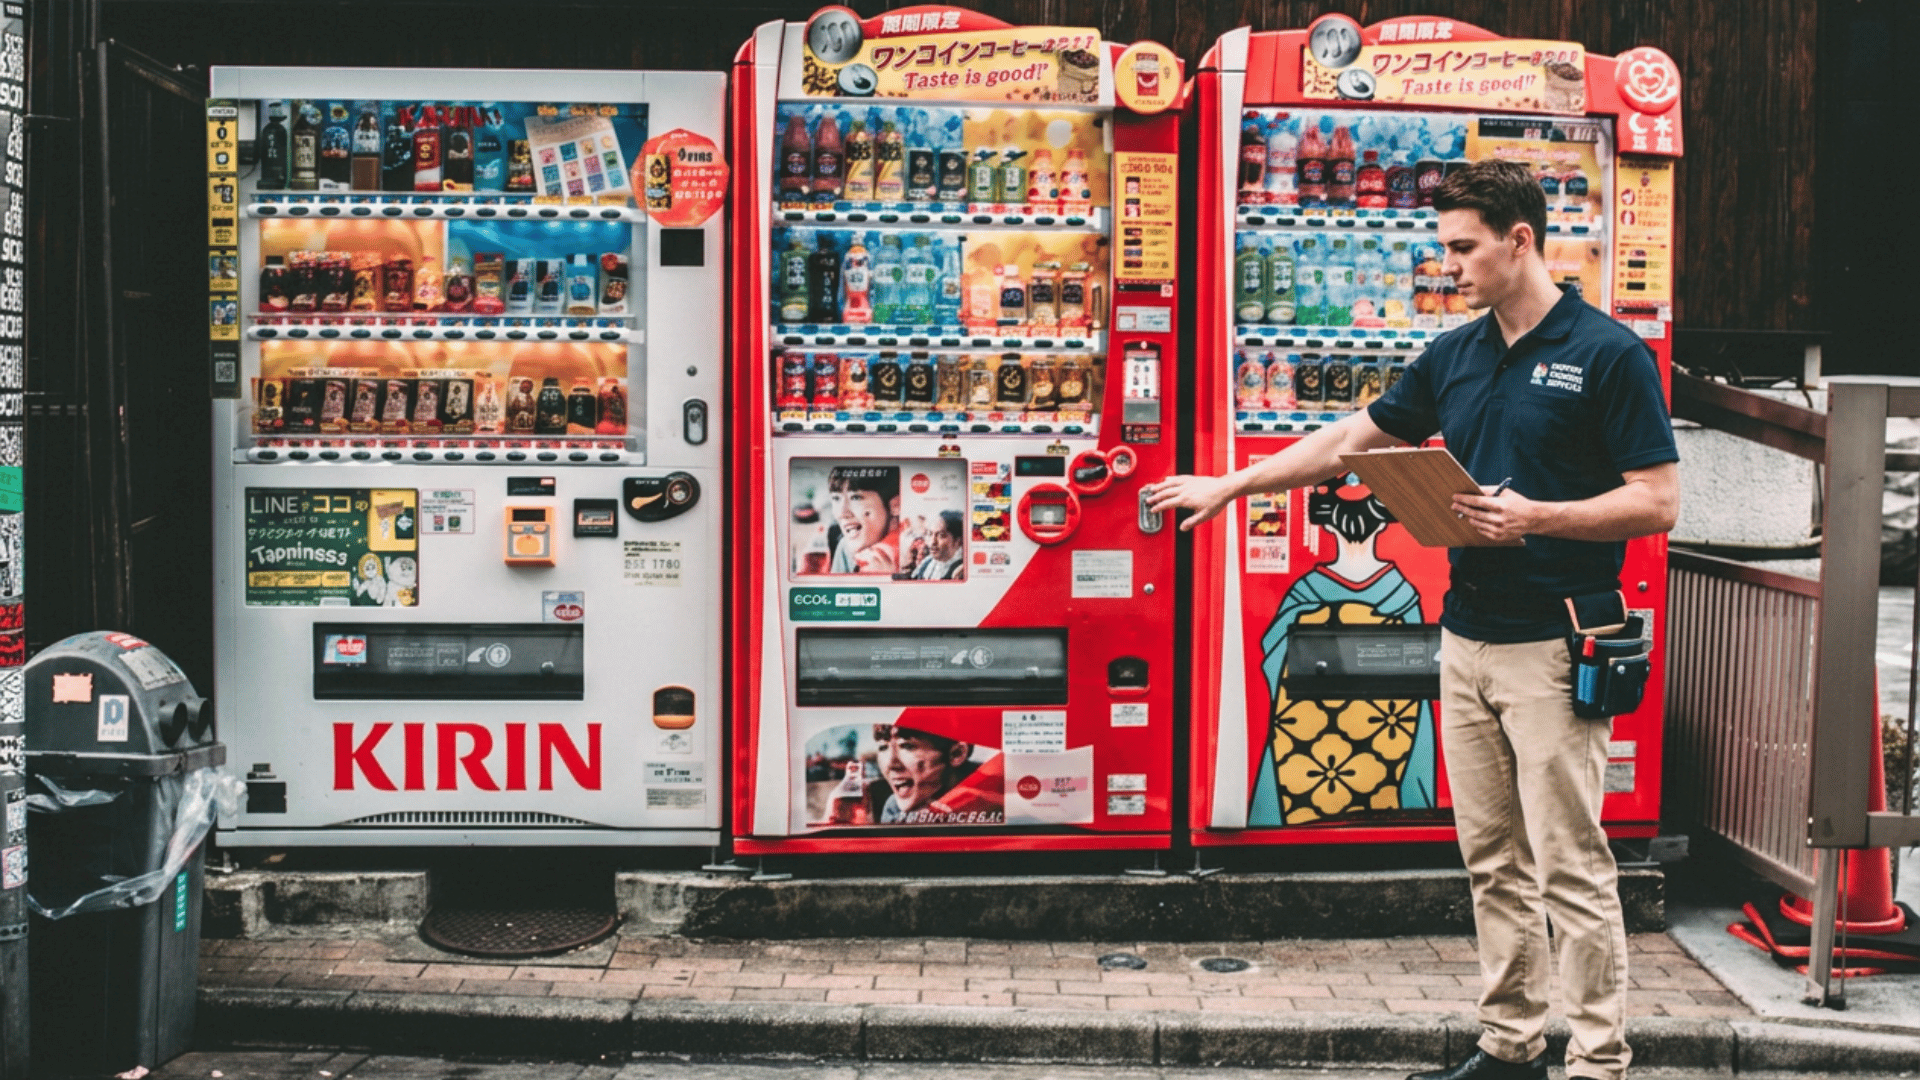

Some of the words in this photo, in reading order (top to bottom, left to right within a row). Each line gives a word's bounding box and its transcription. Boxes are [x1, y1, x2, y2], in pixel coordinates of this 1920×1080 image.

[904, 72, 959, 89] Taste
[965, 69, 981, 84] is
[1402, 78, 1456, 95] Taste
[1459, 77, 1474, 93] is
[250, 496, 298, 514] LINE
[332, 722, 602, 792] KIRIN
